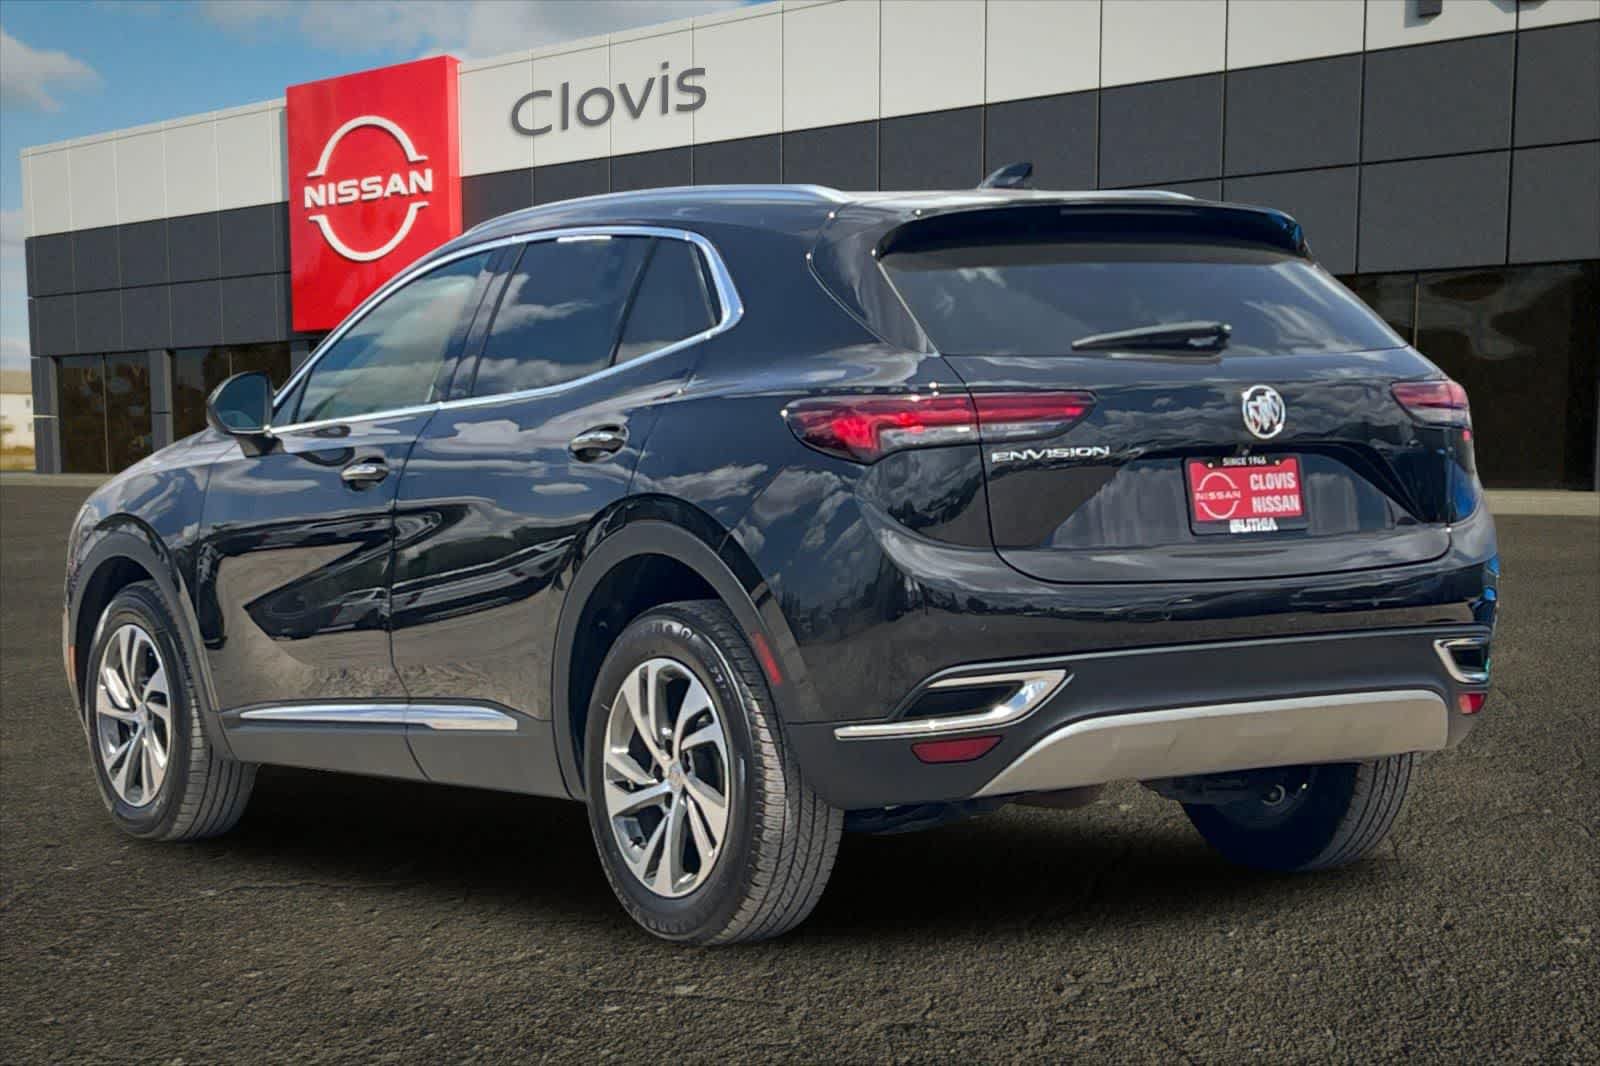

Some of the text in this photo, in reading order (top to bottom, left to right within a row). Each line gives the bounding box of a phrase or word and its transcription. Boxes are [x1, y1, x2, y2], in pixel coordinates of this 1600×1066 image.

[511, 62, 706, 136] Clovis
[304, 168, 433, 208] NISSAN
[992, 446, 1110, 462] ENVISION
[1249, 472, 1296, 490] CLOVIS
[1195, 490, 1241, 500] NISSAN
[1252, 494, 1300, 513] NISSAN
